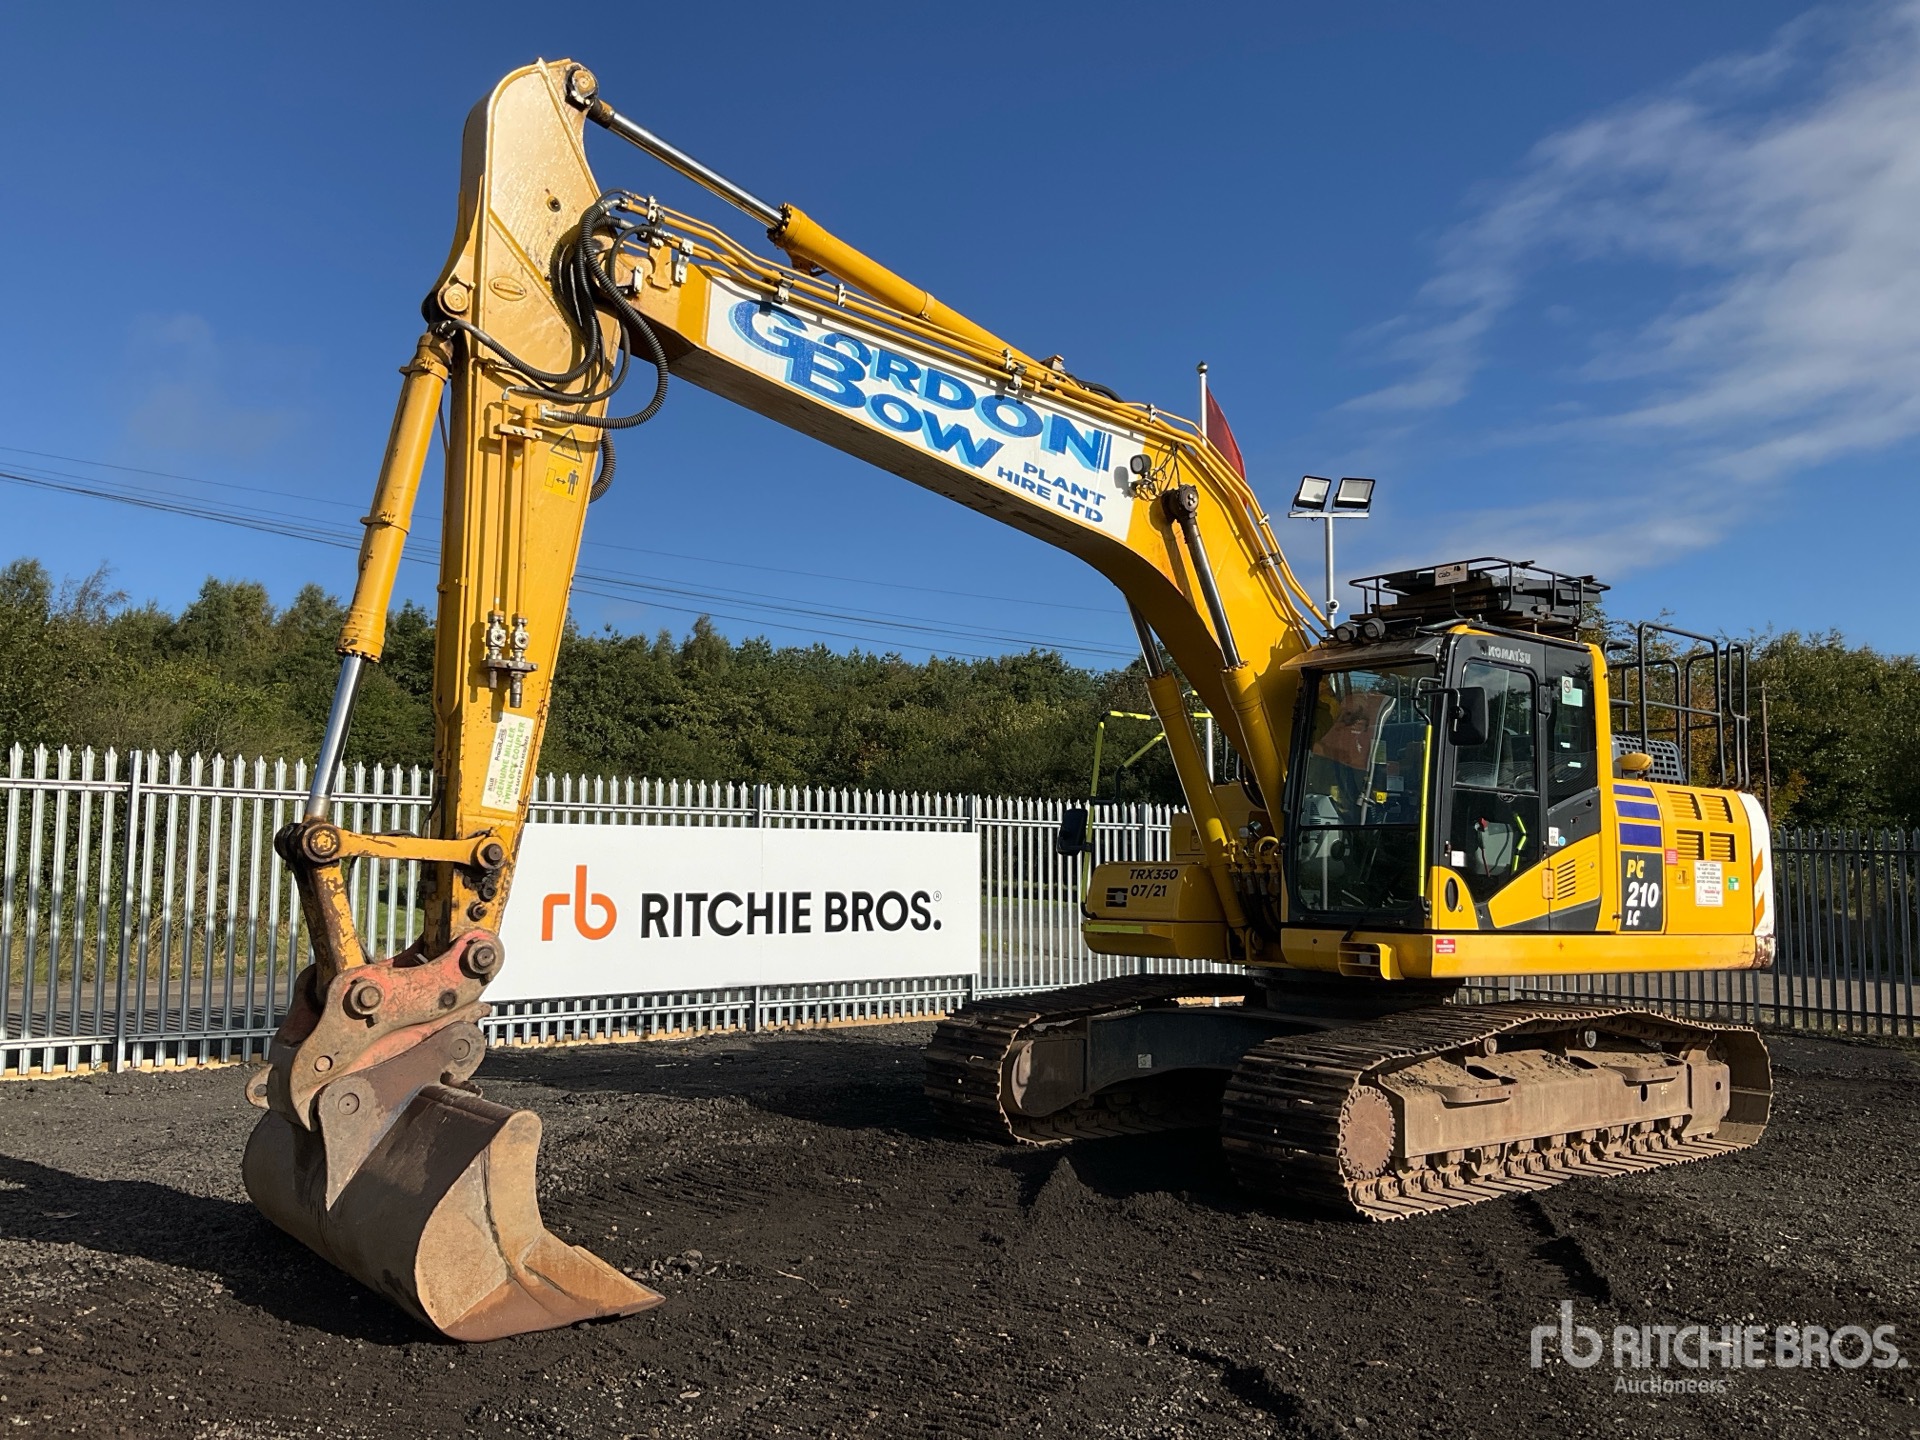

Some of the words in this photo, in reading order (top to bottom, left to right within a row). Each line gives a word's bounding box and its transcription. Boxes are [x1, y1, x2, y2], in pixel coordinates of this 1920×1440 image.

[727, 300, 1108, 473] GORDON
[784, 330, 1004, 469] BOW
[997, 466, 1052, 501] HIRE
[1056, 493, 1104, 523] LTD
[1023, 461, 1106, 507] PLANT
[1488, 645, 1531, 665] KOMATSU
[512, 721, 526, 761] COUPLER
[496, 758, 510, 797] GENUINE
[504, 726, 516, 758] MILLER
[1129, 868, 1179, 881] TRX350
[1626, 858, 1645, 879] PC
[1130, 883, 1168, 898] 07/21
[1625, 881, 1659, 908] 210
[640, 890, 812, 939] RITCHIE
[1625, 910, 1641, 926] LC
